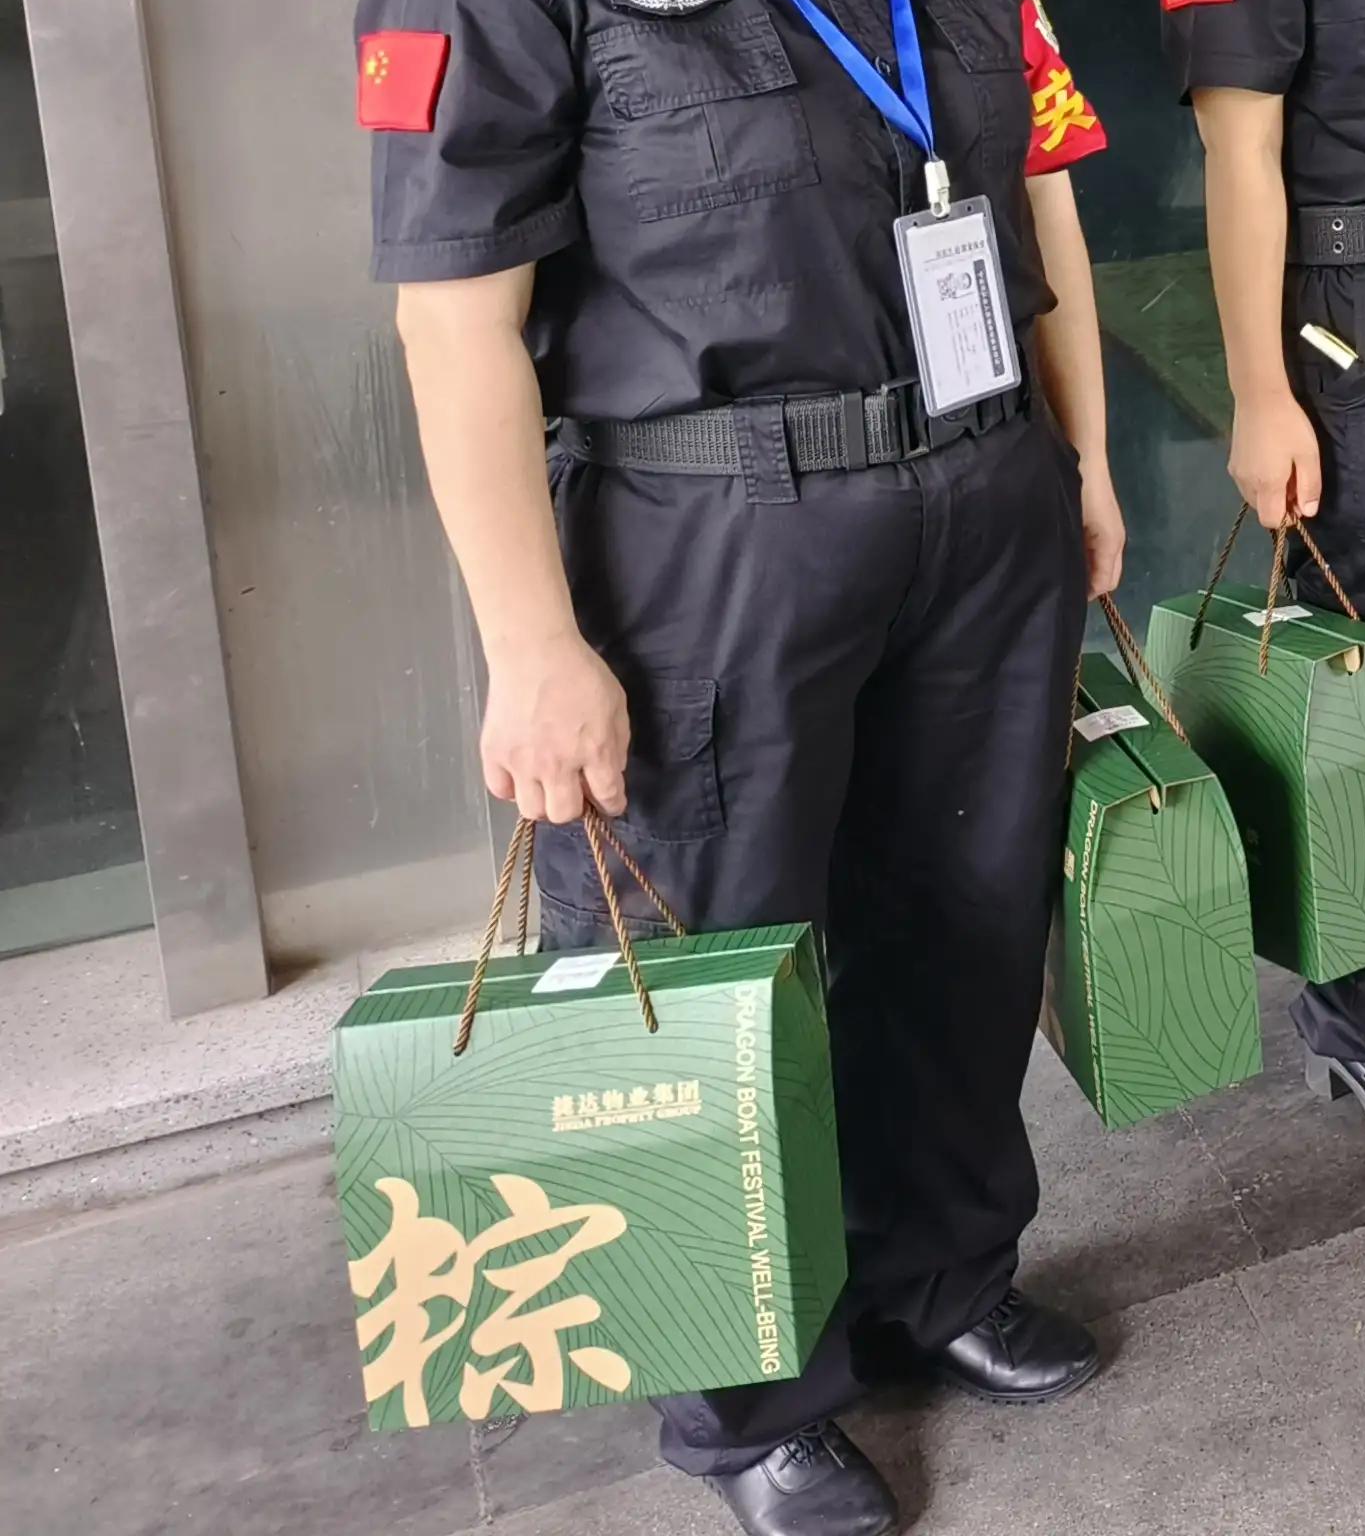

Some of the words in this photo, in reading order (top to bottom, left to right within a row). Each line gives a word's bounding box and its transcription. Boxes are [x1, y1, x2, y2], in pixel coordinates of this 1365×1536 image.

[1032, 68, 1097, 152] 安
[1080, 799, 1099, 880] DRAGON
[734, 984, 758, 1083] DRAGON
[737, 1086, 760, 1145] BOAT
[740, 1149, 768, 1248] FESTIVAL
[751, 1249, 780, 1375] WELL-BEING
